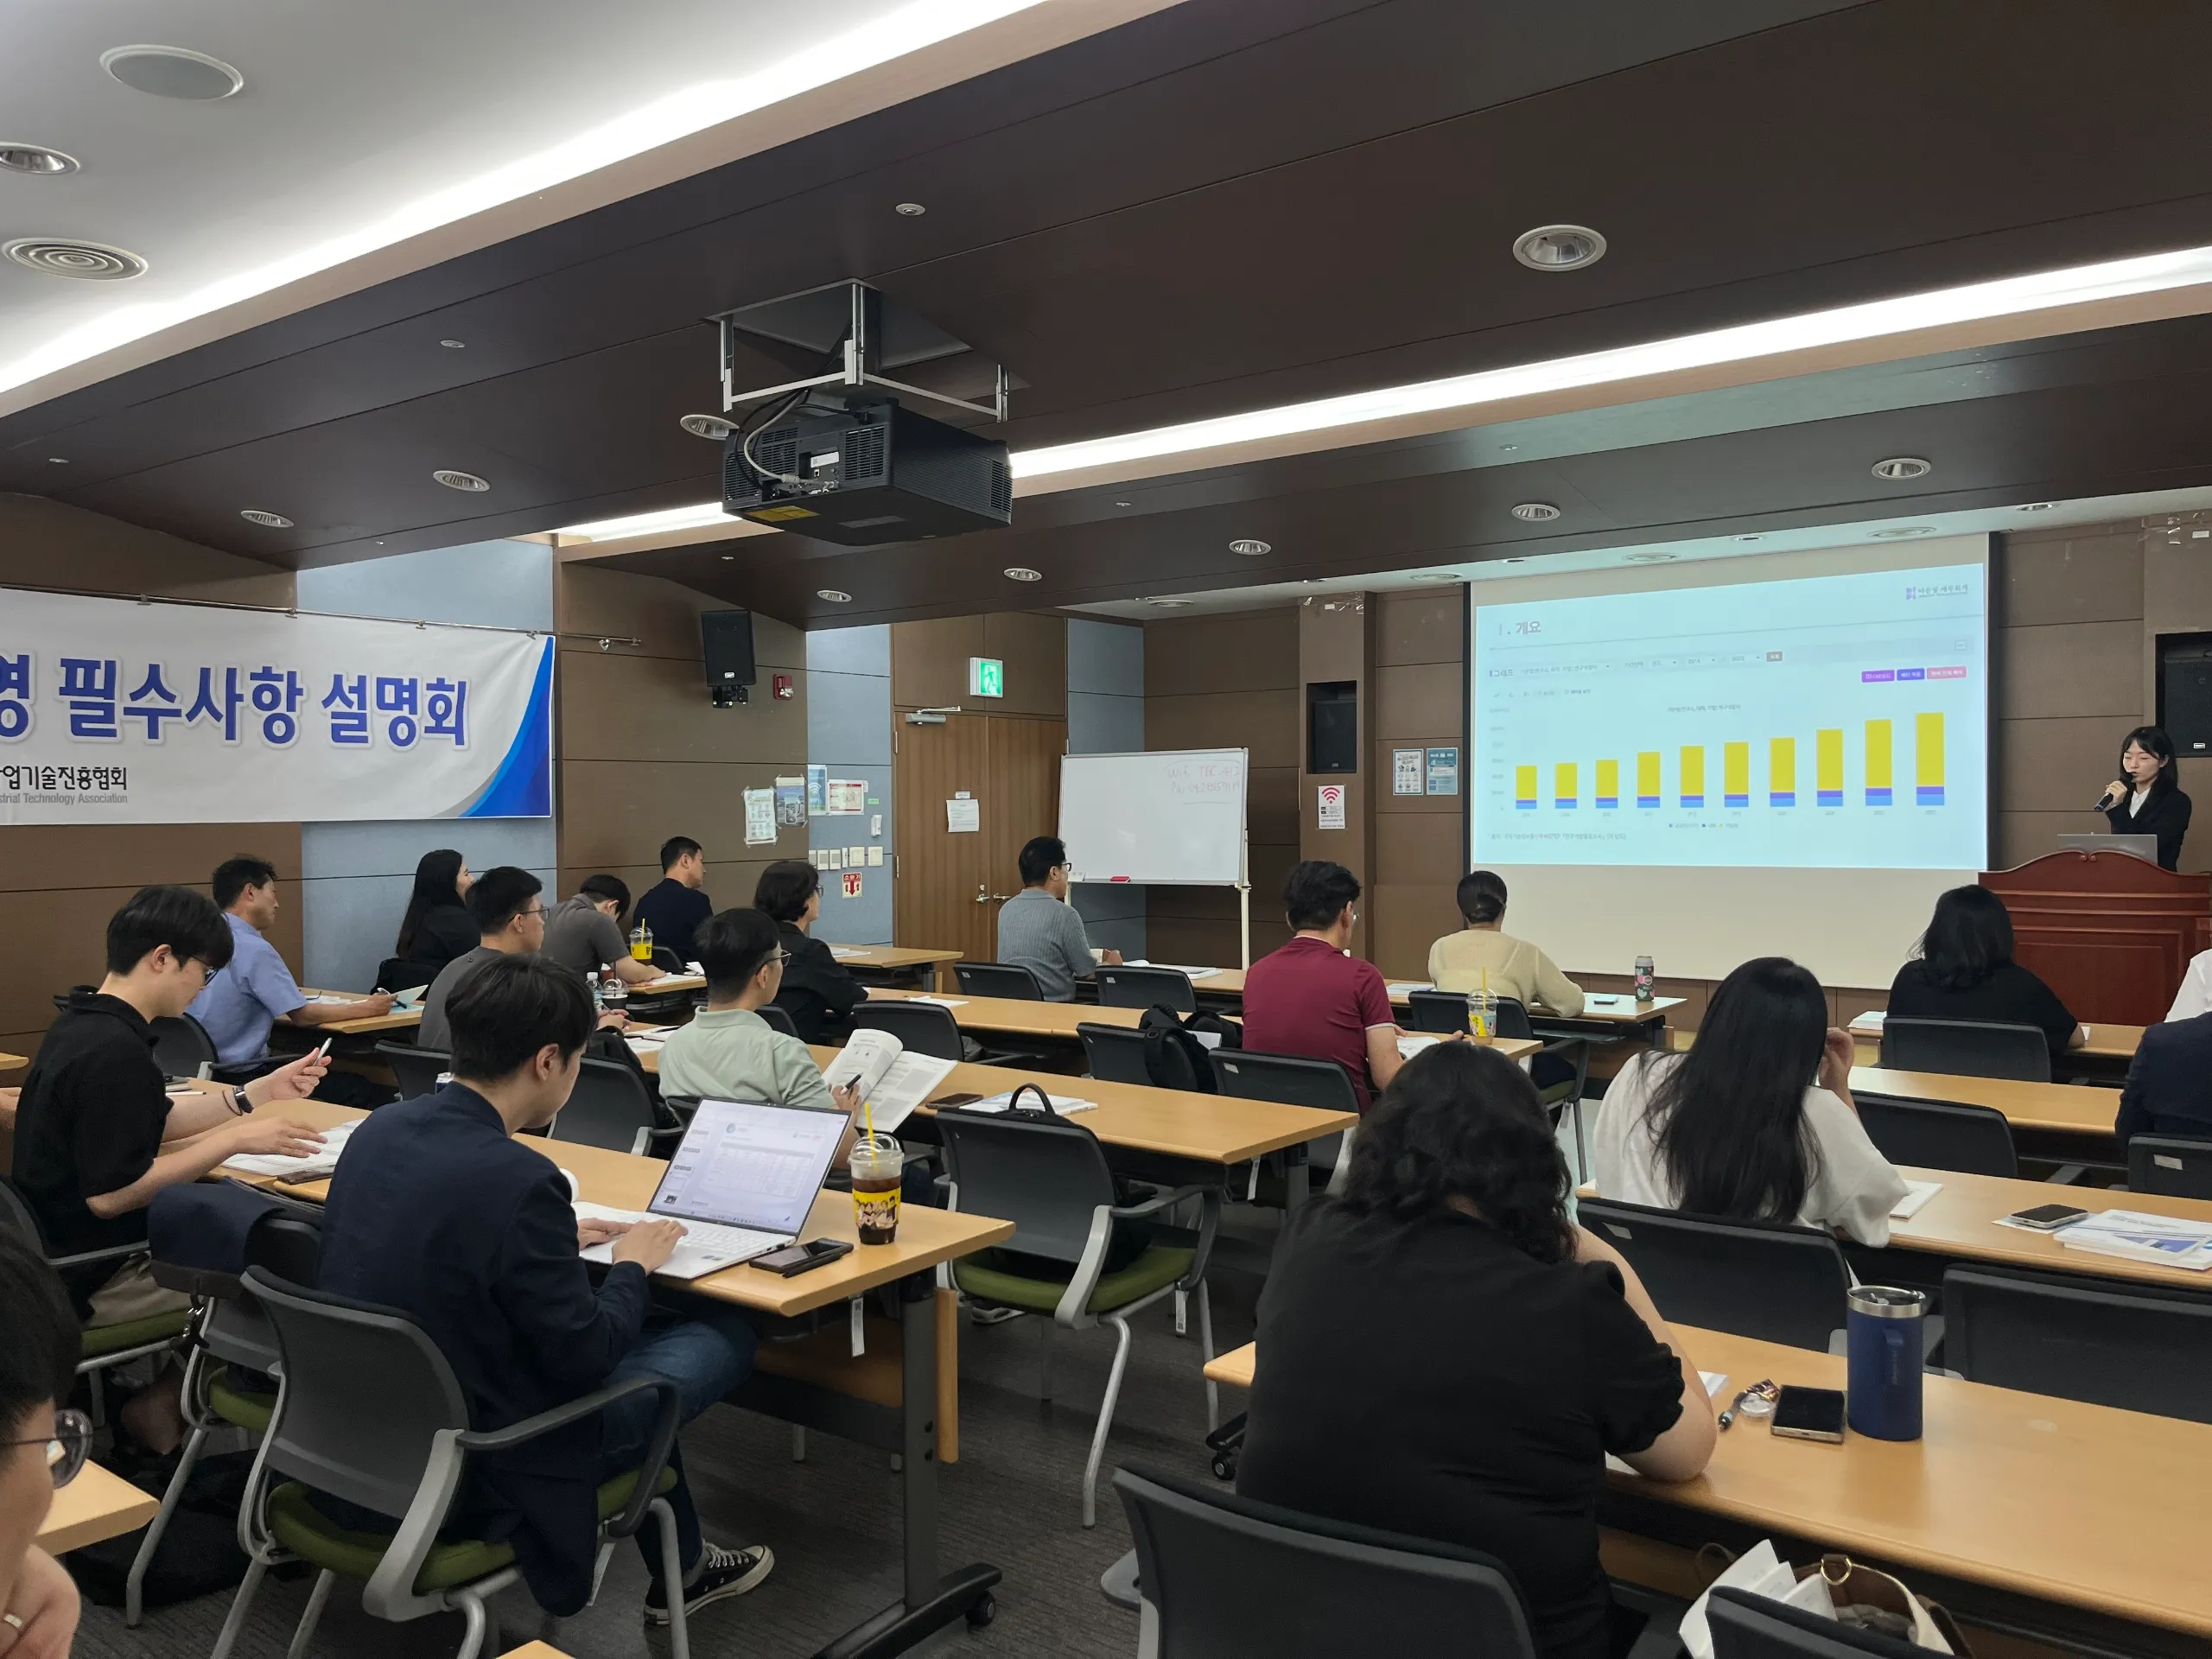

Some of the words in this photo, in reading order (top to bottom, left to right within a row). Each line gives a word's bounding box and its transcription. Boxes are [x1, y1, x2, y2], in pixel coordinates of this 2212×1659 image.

[1516, 620, 1541, 635] 개요
[59, 658, 304, 745] 필수사항
[321, 673, 468, 747] 설명회
[0, 765, 127, 790] 업기술진흥협회
[23, 792, 75, 805] Technology
[78, 792, 128, 804] Association
